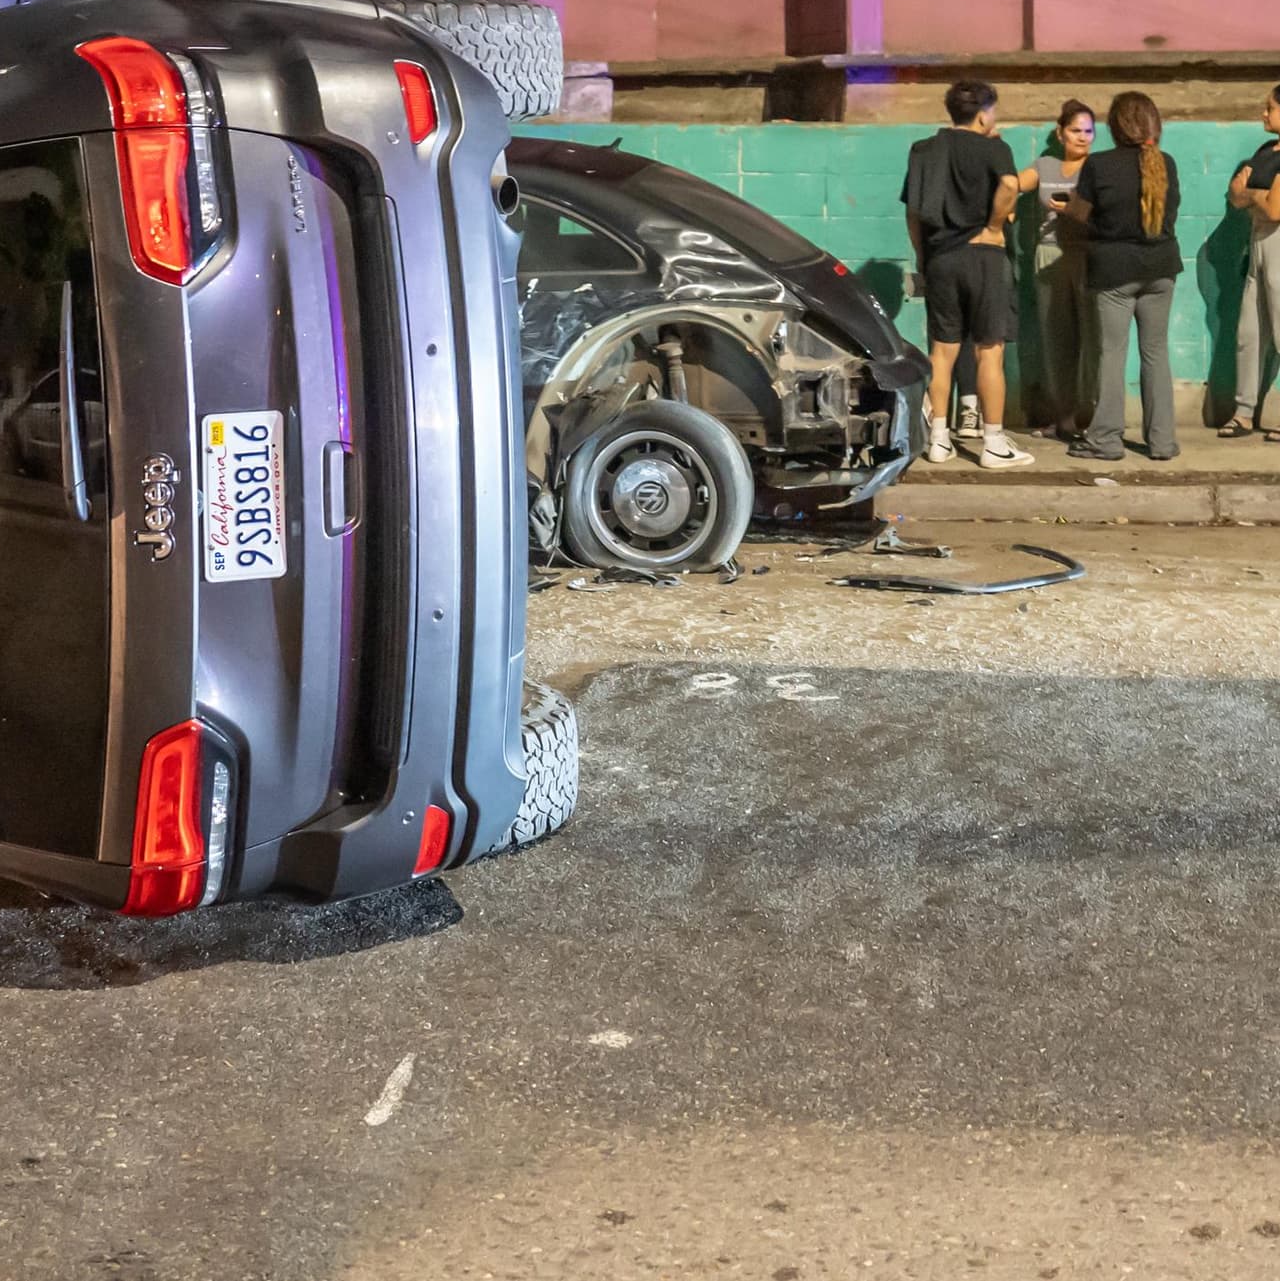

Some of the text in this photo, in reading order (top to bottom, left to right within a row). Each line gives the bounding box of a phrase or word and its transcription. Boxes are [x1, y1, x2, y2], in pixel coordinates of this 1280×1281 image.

[134, 452, 181, 562] Jeep
[211, 446, 234, 547] California
[233, 424, 274, 567] 9SBS816
[273, 451, 281, 535] dmv.ca.gov
[214, 551, 225, 571] SEP
